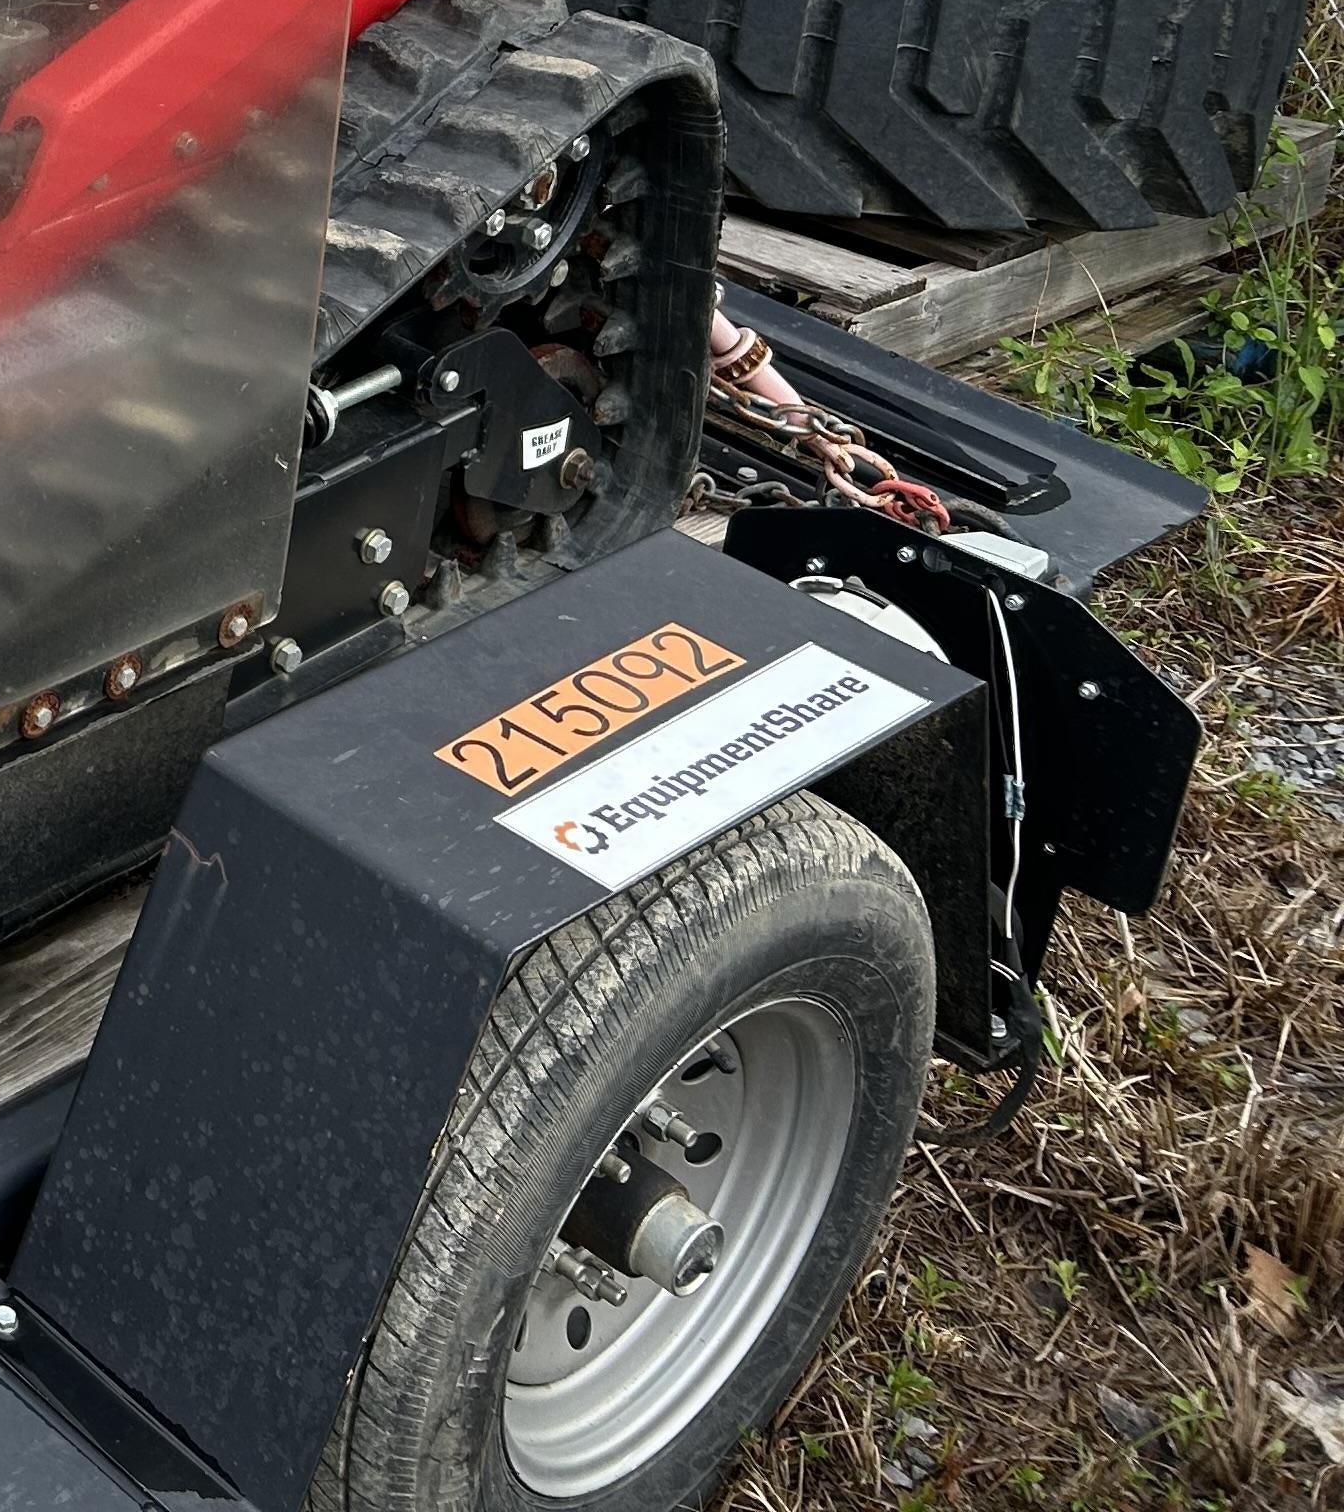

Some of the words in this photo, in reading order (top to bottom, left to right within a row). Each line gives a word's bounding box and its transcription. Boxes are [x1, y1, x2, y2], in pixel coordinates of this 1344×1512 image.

[531, 428, 563, 447] GREASE
[536, 442, 557, 458] DAILY
[450, 630, 737, 790] 215092
[588, 672, 871, 834] EquipmentShare
